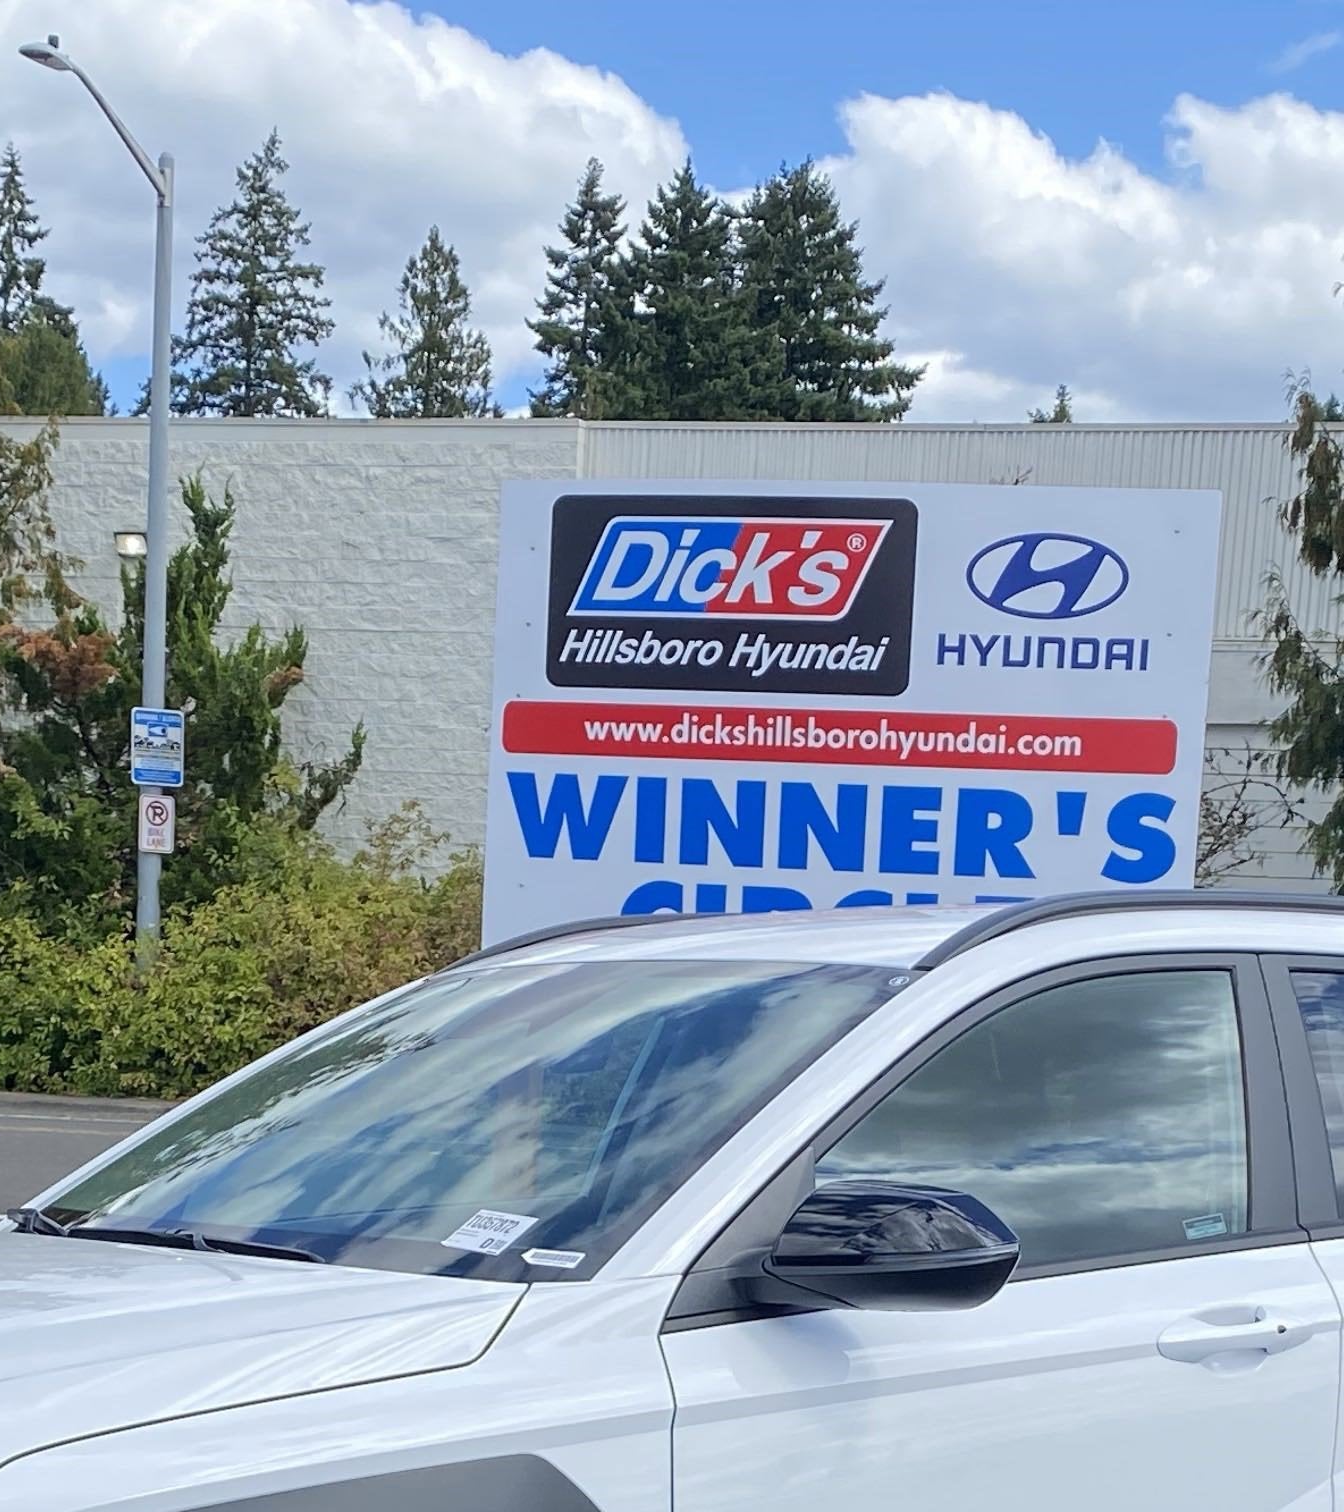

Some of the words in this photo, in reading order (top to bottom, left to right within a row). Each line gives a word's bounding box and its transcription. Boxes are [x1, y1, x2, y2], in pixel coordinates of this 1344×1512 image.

[560, 629, 725, 667] Hillsboro
[729, 633, 891, 676] Hyundai
[936, 633, 1150, 671] HYUNDAI
[584, 712, 1082, 758] www.dickshillsborohyundai.com
[507, 772, 1177, 884] WINNER'S
